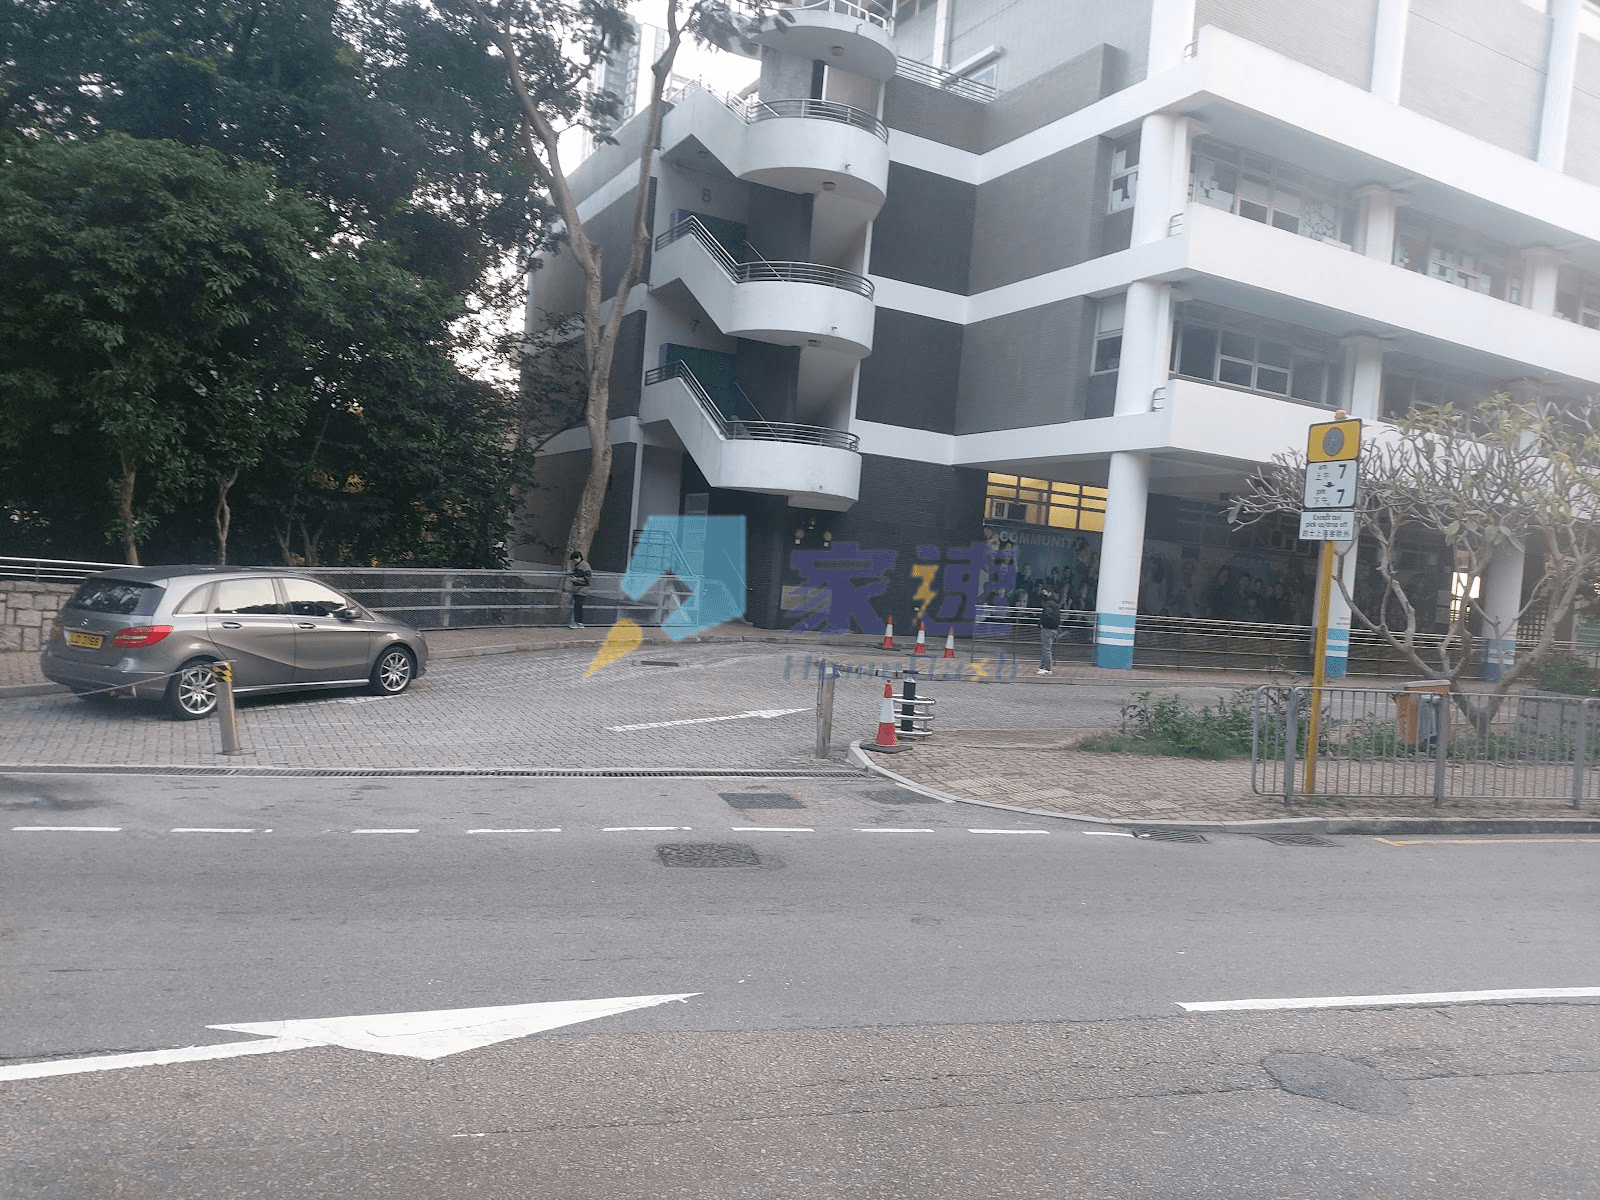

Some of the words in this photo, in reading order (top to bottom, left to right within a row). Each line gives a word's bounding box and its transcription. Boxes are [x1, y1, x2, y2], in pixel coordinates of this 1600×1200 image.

[1338, 464, 1346, 479] 7
[1336, 489, 1345, 504] 7
[1313, 513, 1331, 521] Except
[999, 530, 1083, 551] COMMUNITY
